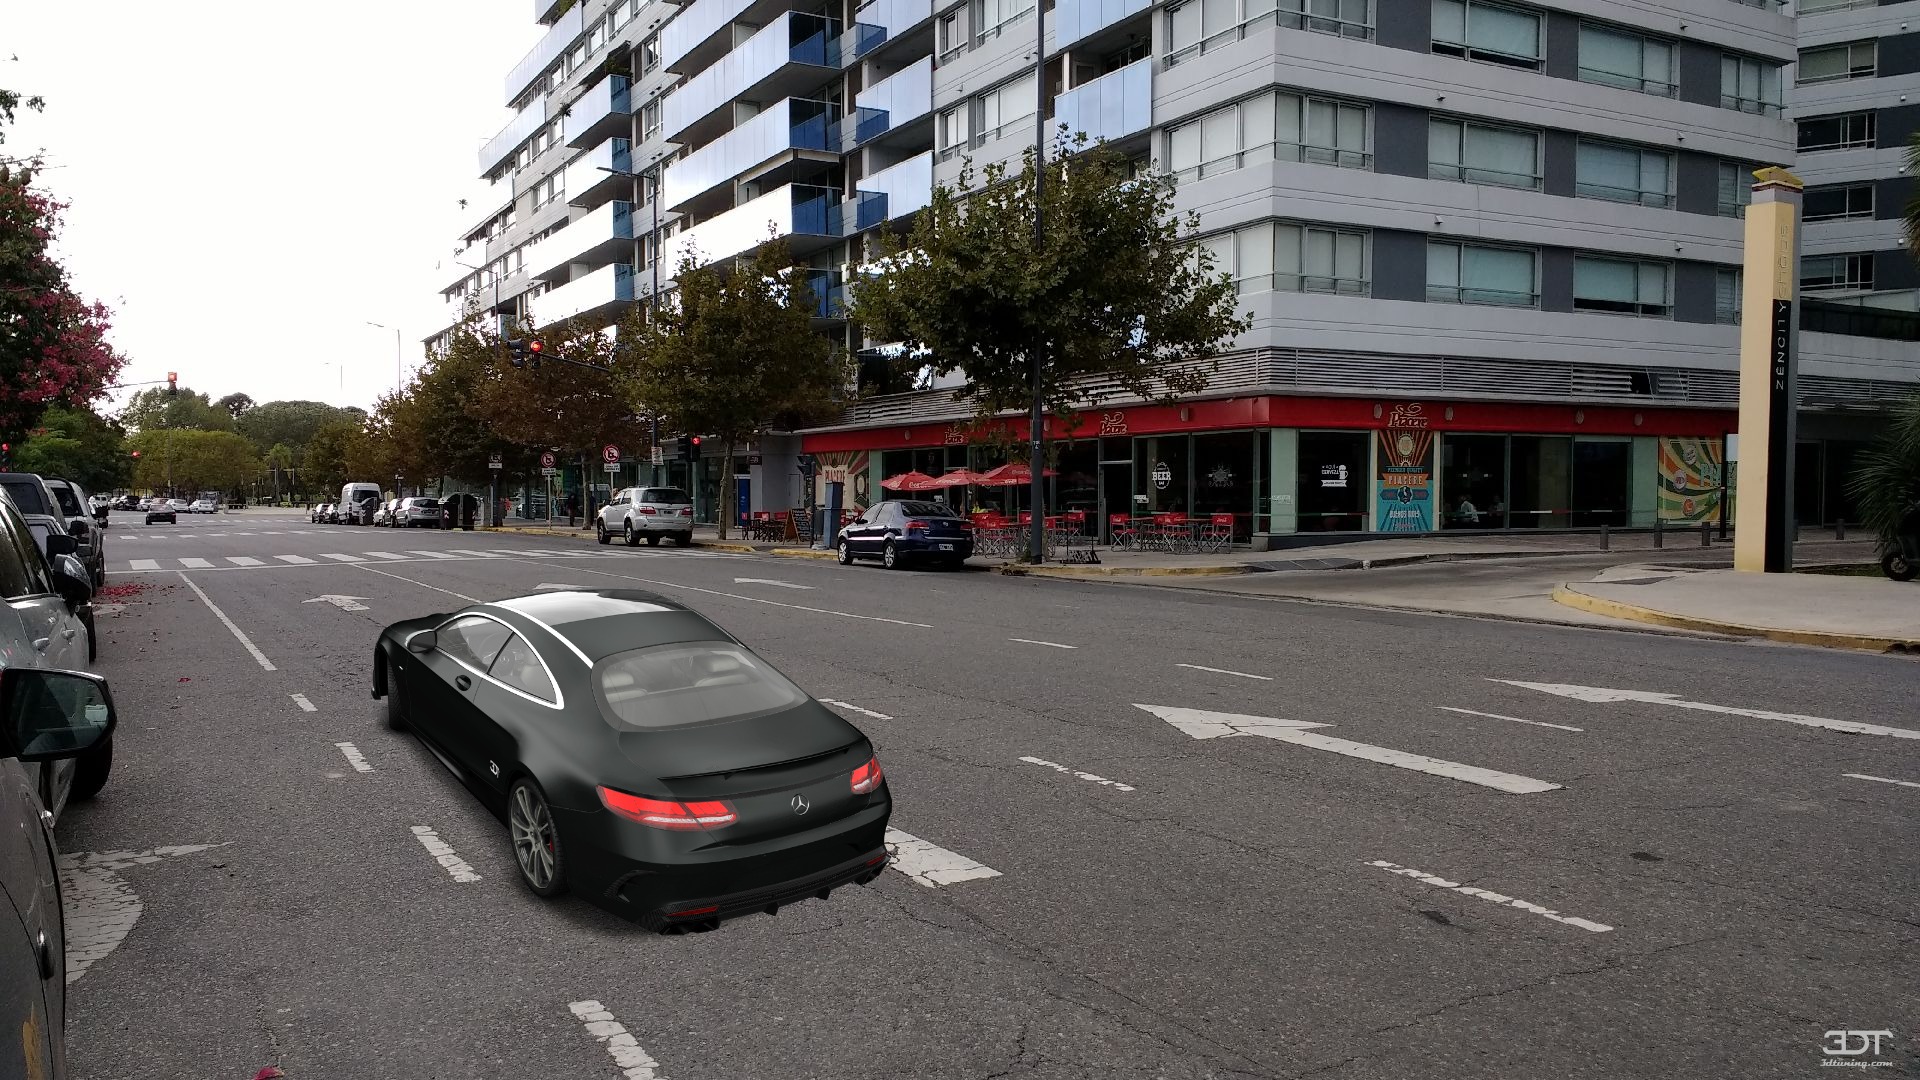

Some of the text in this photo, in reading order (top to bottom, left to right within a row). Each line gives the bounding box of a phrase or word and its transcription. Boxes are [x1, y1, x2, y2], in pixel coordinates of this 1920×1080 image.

[1775, 300, 1787, 391] ZENCITY
[1151, 471, 1172, 481] BEER
[1388, 475, 1423, 485] PIACERE
